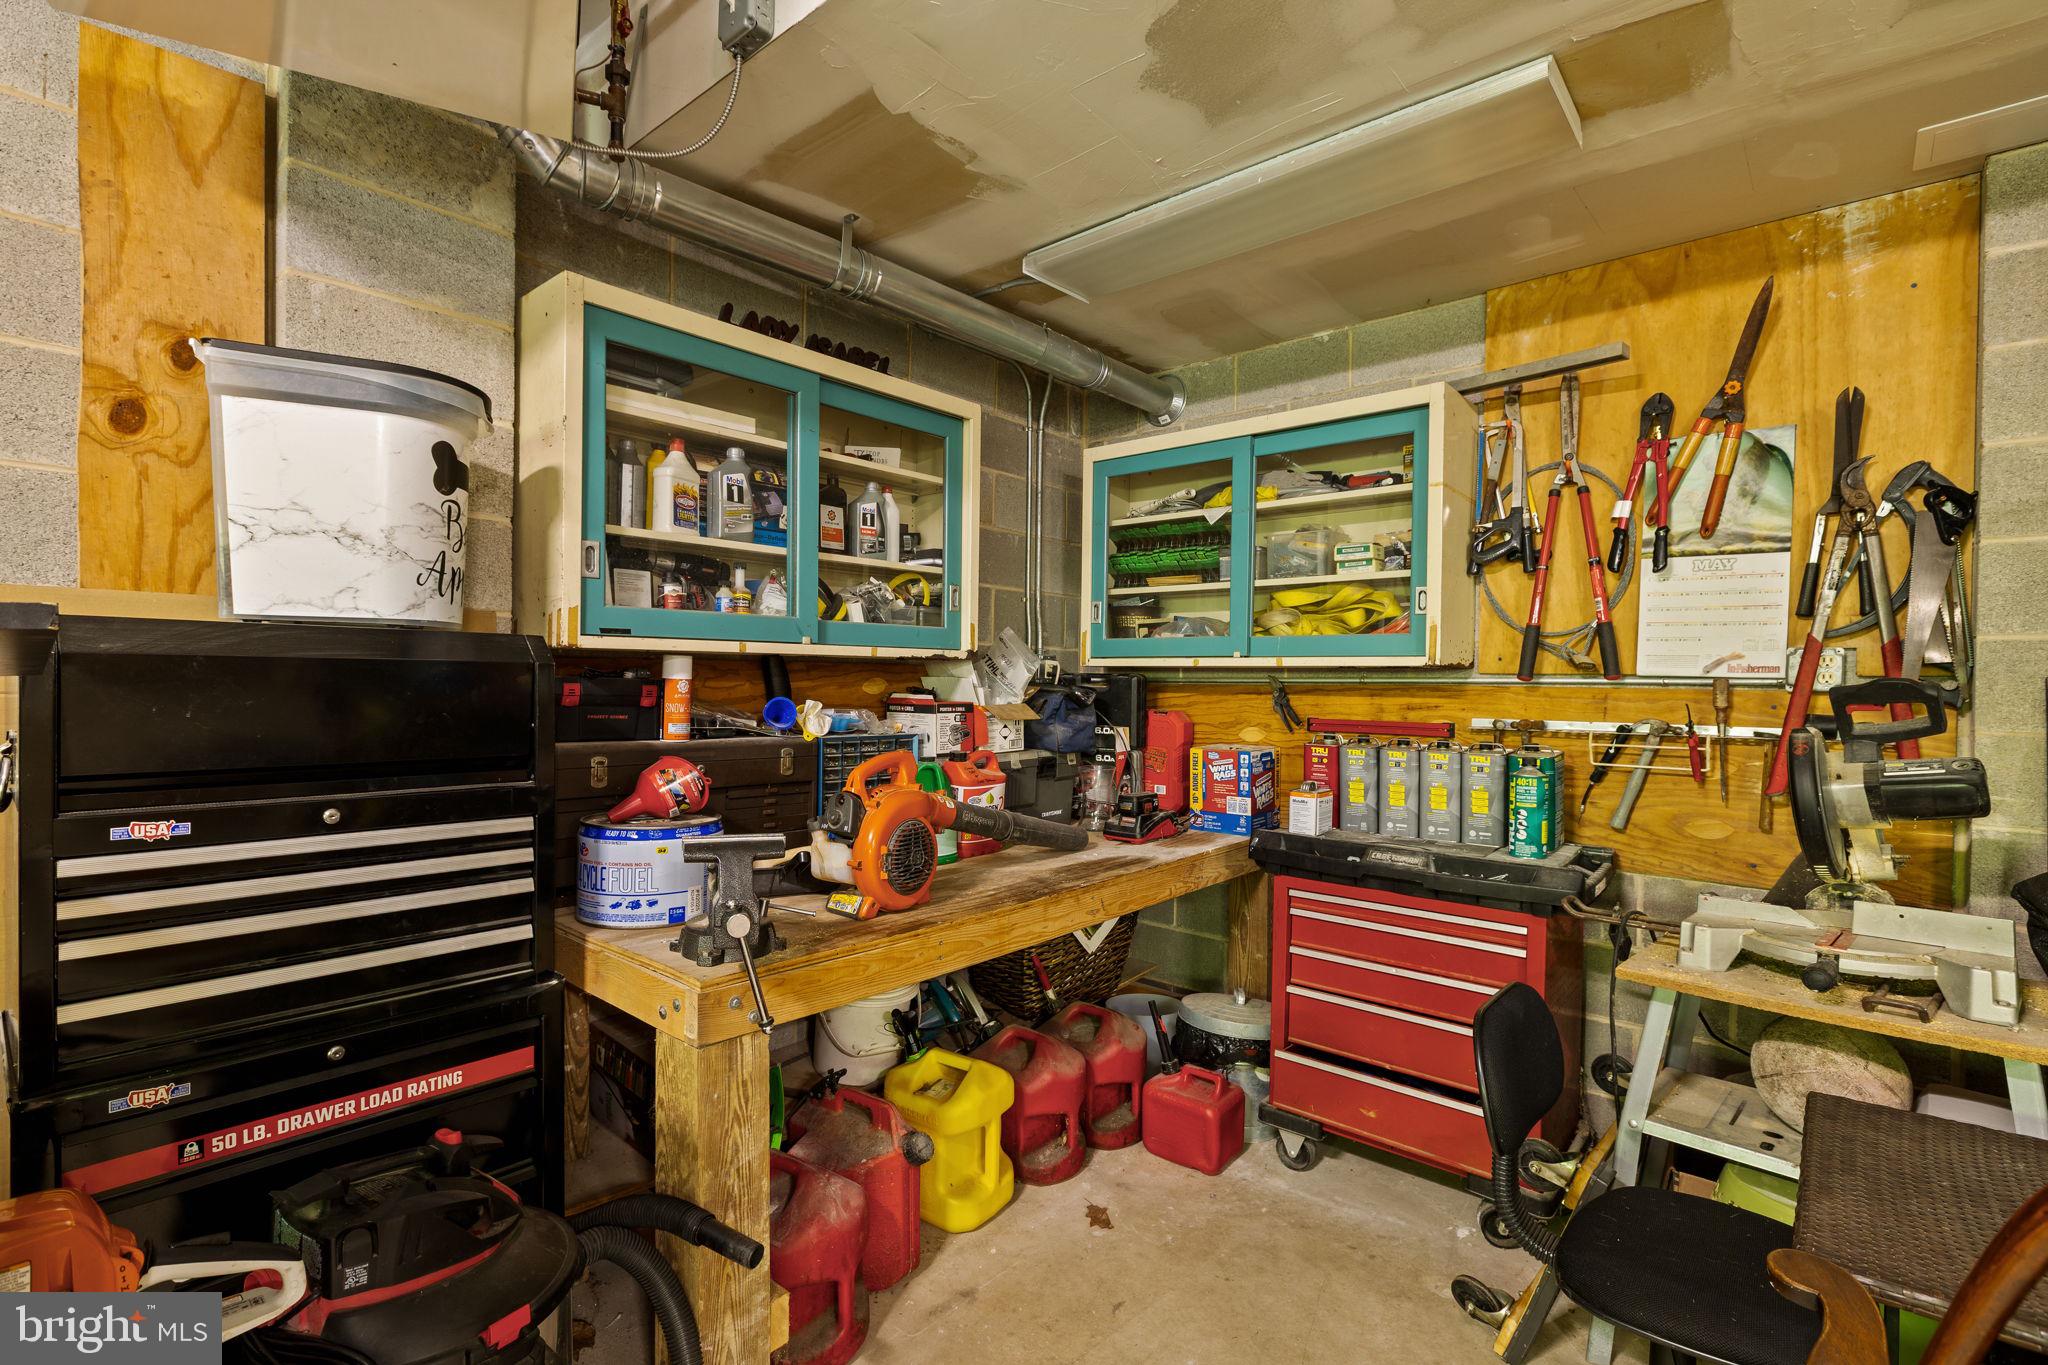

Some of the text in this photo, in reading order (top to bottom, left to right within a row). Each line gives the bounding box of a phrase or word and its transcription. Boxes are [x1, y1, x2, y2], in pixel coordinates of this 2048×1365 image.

[726, 475, 744, 486] Mobil
[1692, 558, 1738, 572] MAY
[416, 551, 465, 607] Ap
[981, 653, 1000, 677] STIHL
[665, 702, 690, 713] SNOW-
[1311, 746, 1329, 754] TRU
[1208, 764, 1234, 773] WHITE
[1213, 769, 1237, 781] RAGS
[134, 824, 169, 838] USA
[605, 829, 619, 837] READY
[1371, 852, 1420, 866] CRAFTSMAN
[607, 867, 660, 893] FUEL
[132, 1088, 168, 1106] USA
[211, 1070, 463, 1153] 50 LB. DRAWER LOAD RATING
